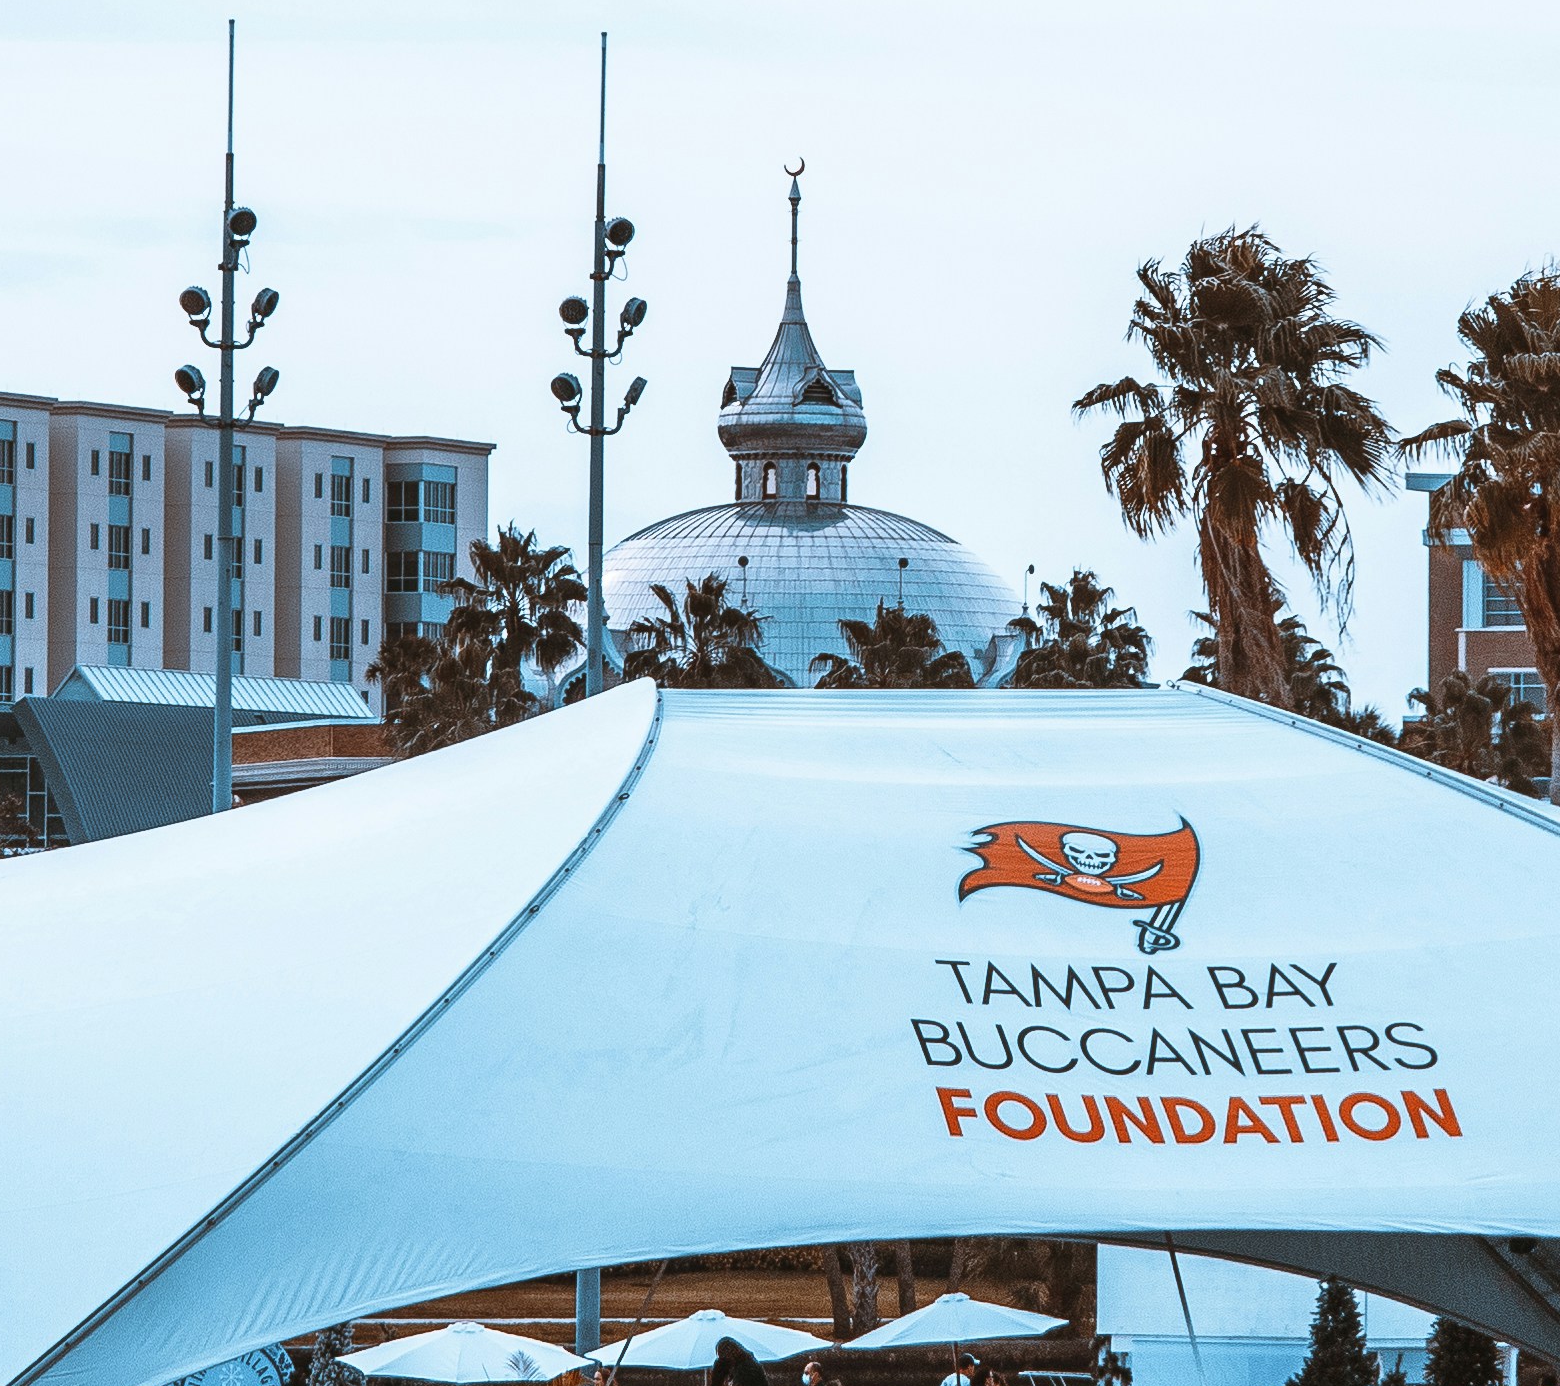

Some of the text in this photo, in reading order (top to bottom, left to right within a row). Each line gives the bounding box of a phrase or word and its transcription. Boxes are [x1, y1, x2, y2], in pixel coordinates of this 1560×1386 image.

[934, 958, 1339, 1010] TAMPA BAY
[910, 1018, 1439, 1077] BUCCANEERS
[935, 1085, 1465, 1146] FOUNDATION
